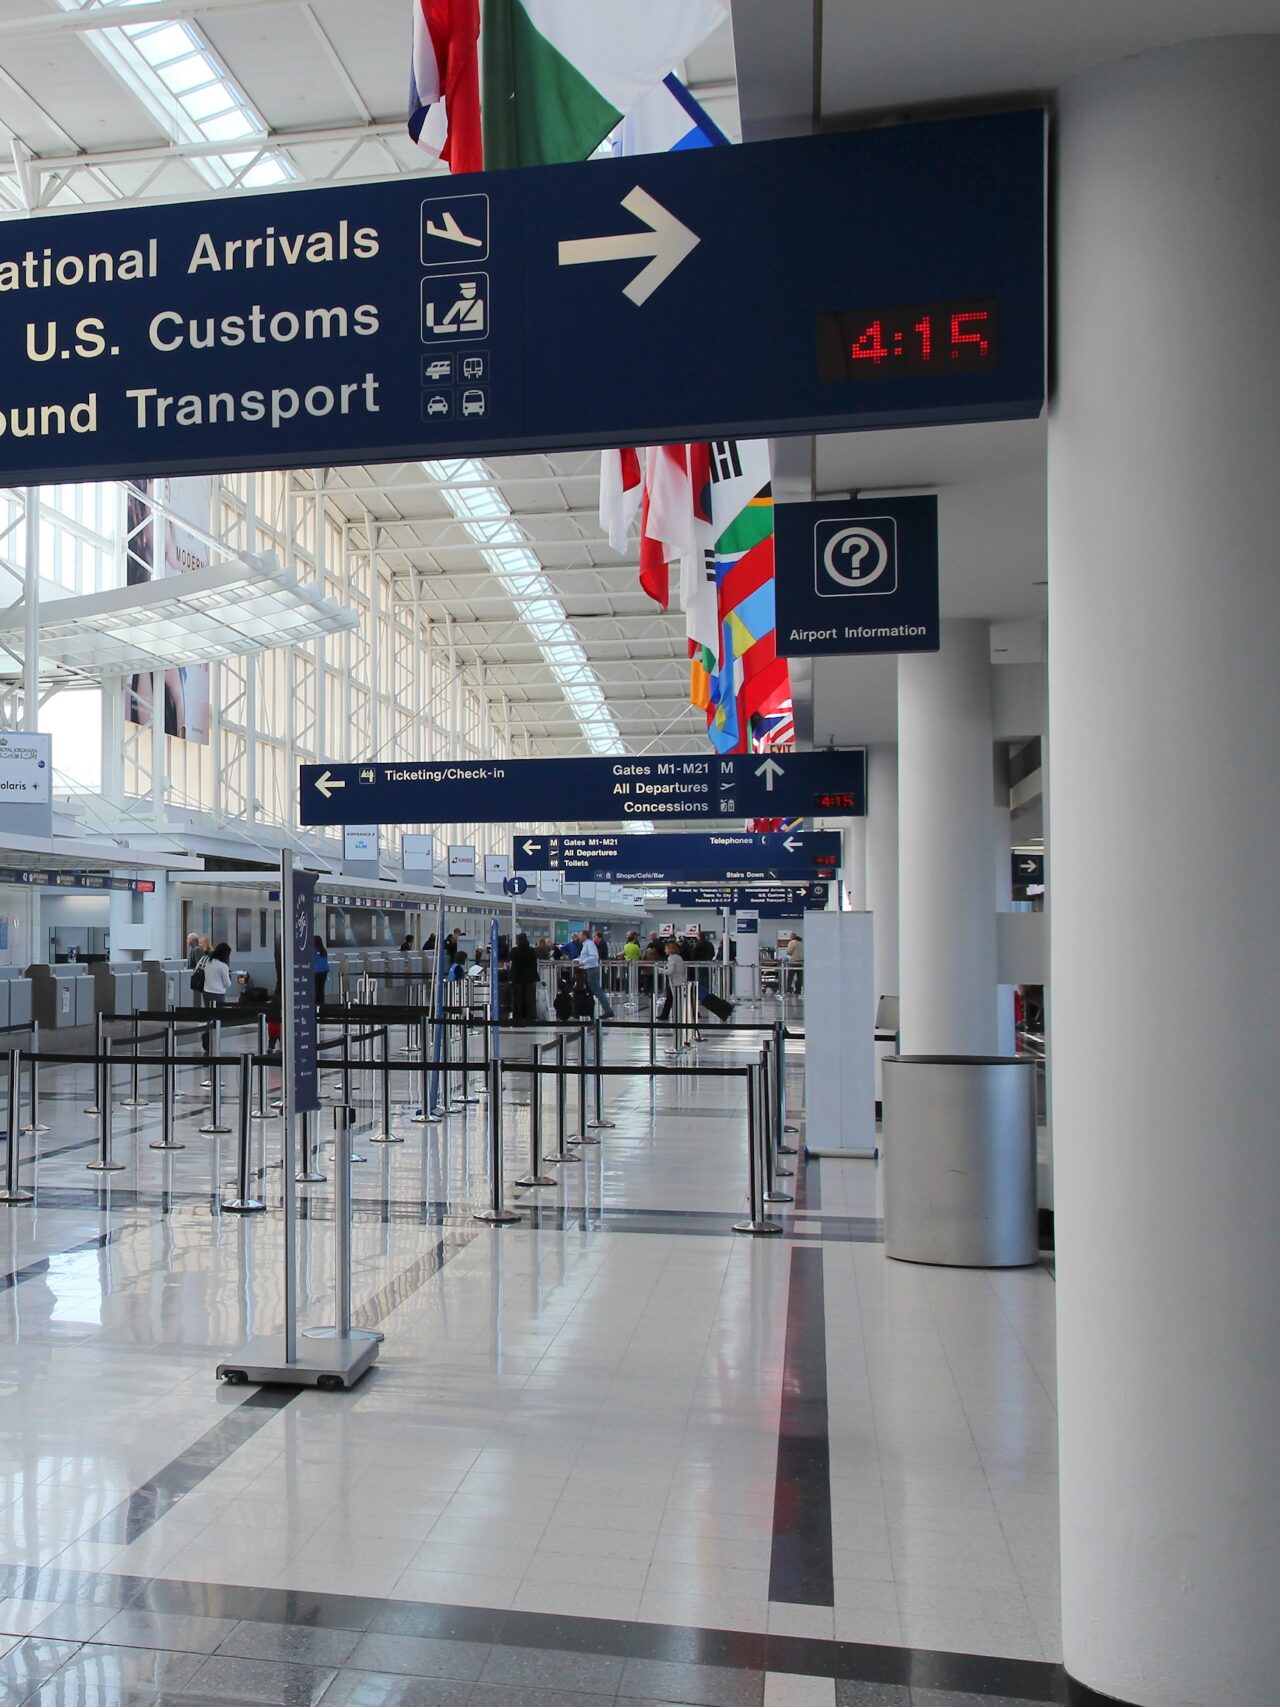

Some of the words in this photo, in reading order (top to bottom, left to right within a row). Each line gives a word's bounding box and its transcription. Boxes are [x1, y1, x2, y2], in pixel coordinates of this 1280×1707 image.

[187, 219, 380, 274] Arrivals
[25, 317, 120, 362] U.S.
[148, 302, 380, 352] Customs
[851, 311, 989, 364] 4:15
[126, 373, 380, 429] Transport
[789, 627, 837, 642] Airport
[845, 624, 926, 639] Information
[613, 764, 651, 775] Gates
[657, 763, 709, 774] M1-M21
[721, 762, 734, 774] M
[385, 768, 505, 782] Ticketing/Check-in
[613, 783, 630, 794] All
[636, 783, 708, 795] Departures
[624, 801, 708, 812] Concessions
[821, 795, 854, 807] 4:15
[710, 837, 753, 845] Telephones
[616, 872, 665, 880] Shops/Café/Bar
